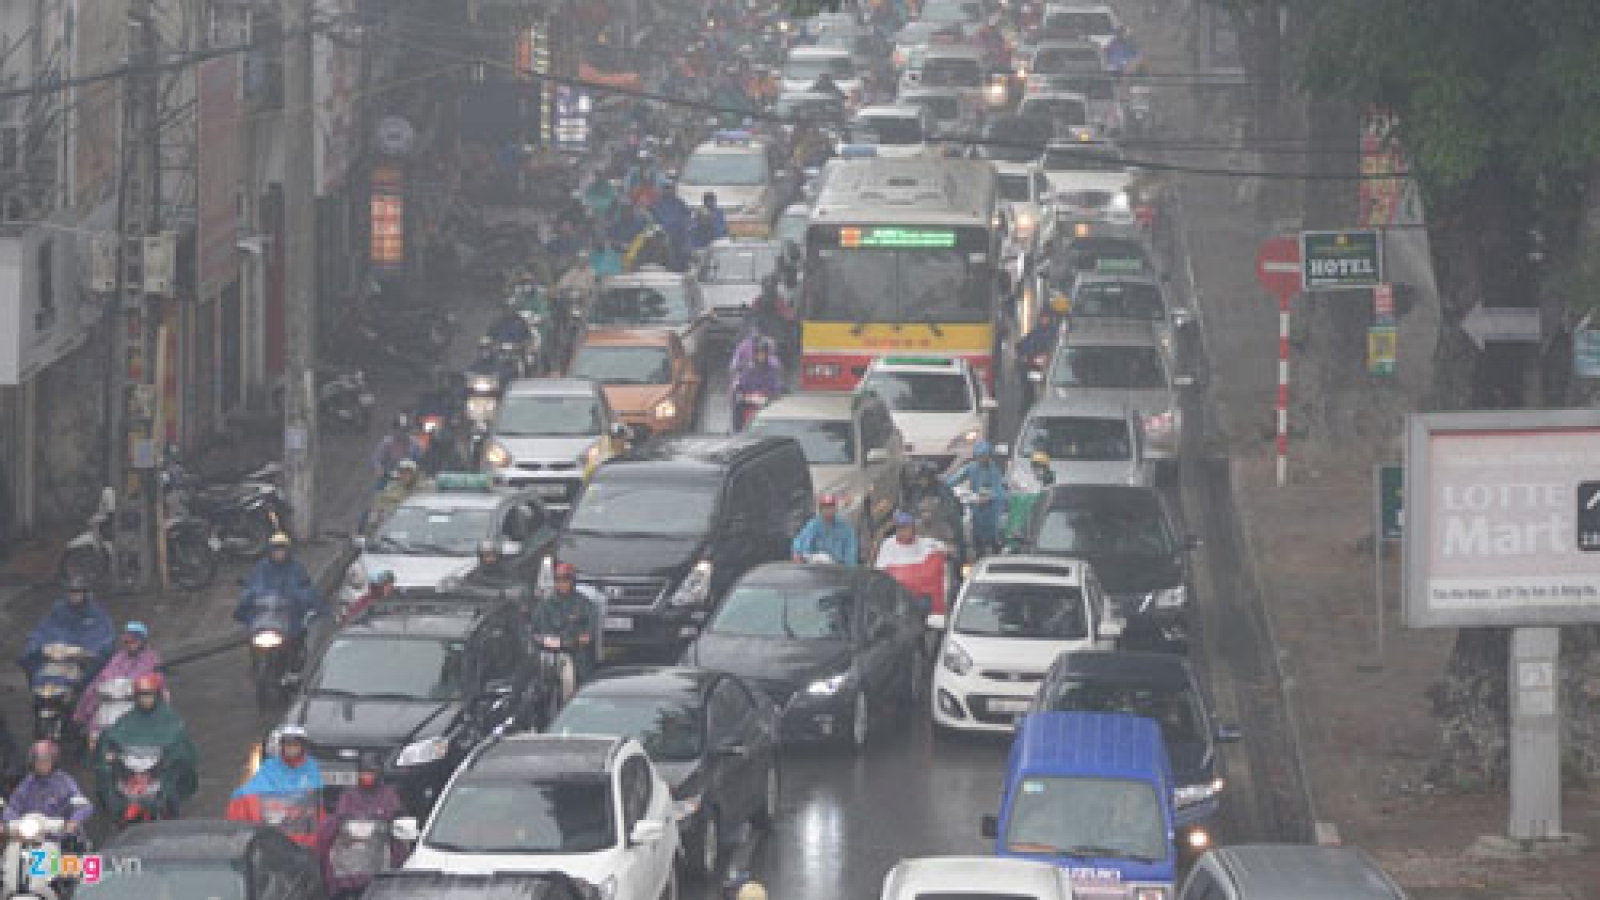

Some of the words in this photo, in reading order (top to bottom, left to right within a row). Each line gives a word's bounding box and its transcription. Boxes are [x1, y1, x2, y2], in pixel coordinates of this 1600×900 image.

[1308, 258, 1373, 276] HOTEL
[1443, 485, 1569, 509] LOTTE
[1442, 512, 1569, 556] Mart
